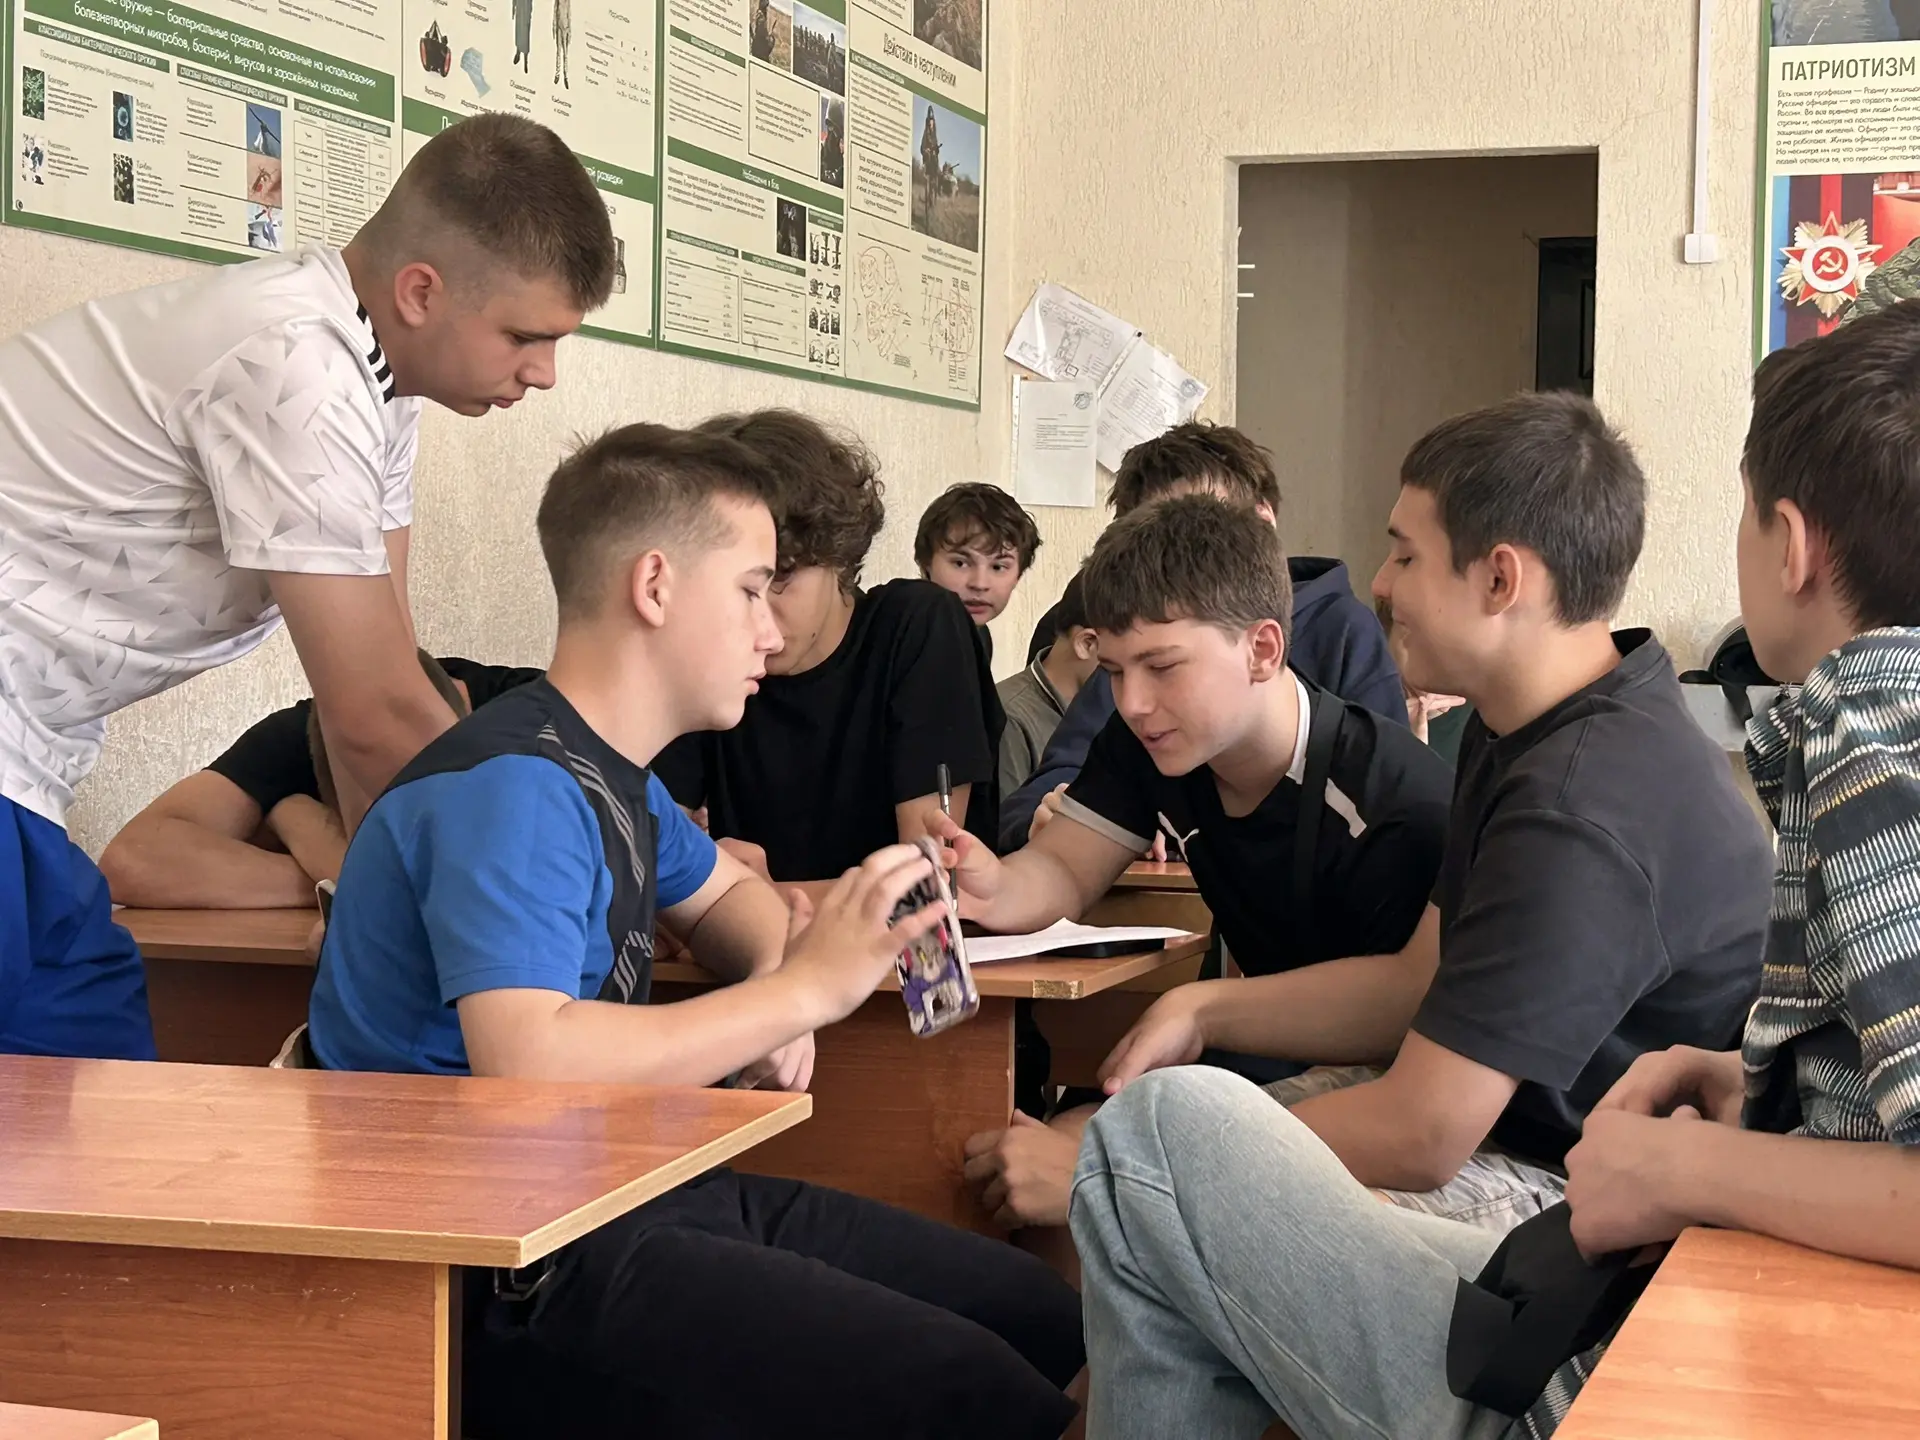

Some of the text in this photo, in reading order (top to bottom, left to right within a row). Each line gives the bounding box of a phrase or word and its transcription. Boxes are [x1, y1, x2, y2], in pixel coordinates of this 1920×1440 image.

[74, 1, 145, 35] болезнетворных
[147, 29, 190, 51] микробов,
[193, 38, 232, 64] бактерий,
[234, 55, 265, 72] вирусов
[267, 65, 272, 74] и
[273, 67, 319, 89] заражённых
[167, 9, 229, 40] бактериальные
[268, 45, 313, 68] основанные
[314, 60, 323, 71] на
[324, 64, 376, 88] использовании
[883, 33, 912, 65] Действия
[1782, 56, 1916, 81] ПАТРИОТИЗМ
[1814, 88, 1852, 98] профессия
[1864, 86, 1888, 95] Родину
[1778, 100, 1804, 108] Русские
[1806, 99, 1838, 108] офицеры
[1858, 125, 1888, 134] Офицер
[1830, 136, 1853, 144] Жизнь
[1855, 135, 1890, 144] офицеров
[1856, 155, 1888, 164] геройски
